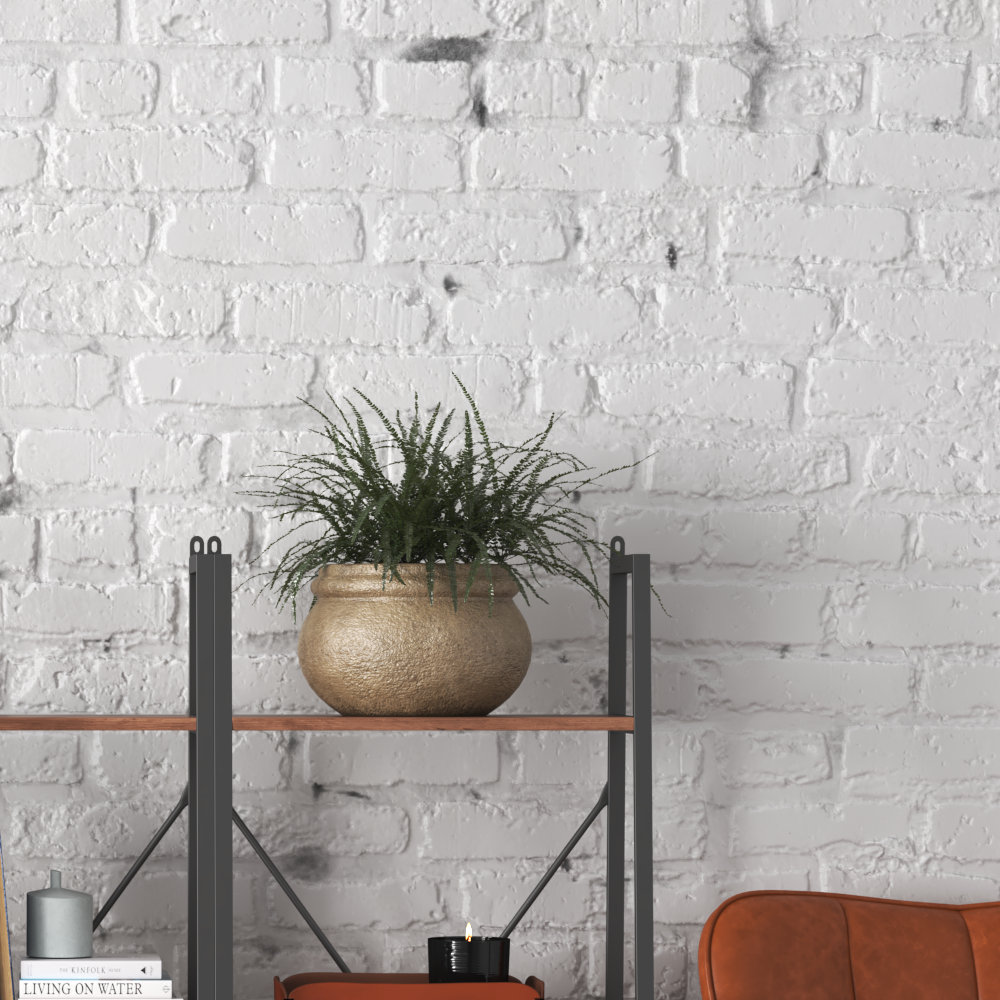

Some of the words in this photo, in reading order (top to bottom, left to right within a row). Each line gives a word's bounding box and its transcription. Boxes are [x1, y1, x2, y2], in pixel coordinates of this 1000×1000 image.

[24, 982, 71, 995] LIVING
[75, 982, 94, 995] ON
[98, 982, 143, 995] WATER
